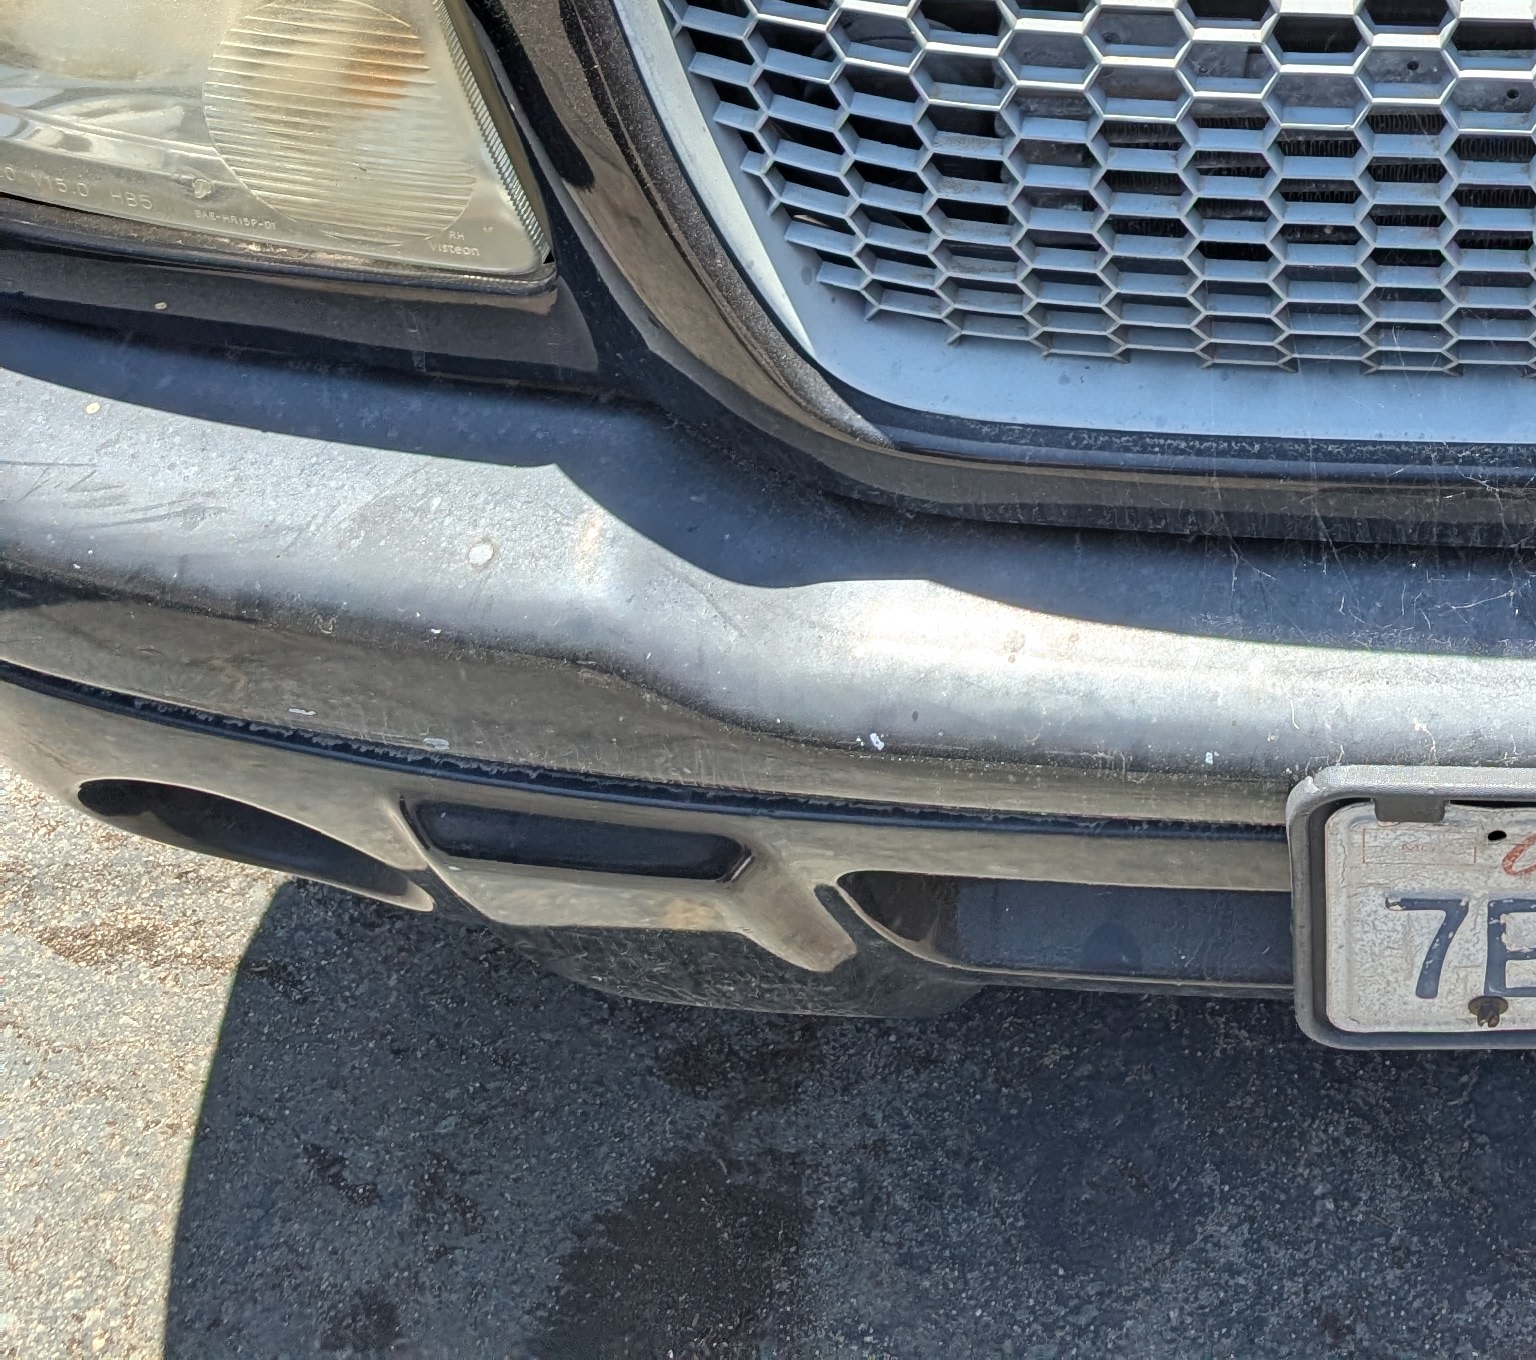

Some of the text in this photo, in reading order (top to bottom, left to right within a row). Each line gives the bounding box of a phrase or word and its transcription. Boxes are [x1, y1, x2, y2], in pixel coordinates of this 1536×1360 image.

[110, 189, 154, 210] HB5
[448, 230, 465, 241] RH
[427, 241, 481, 257] Visteon
